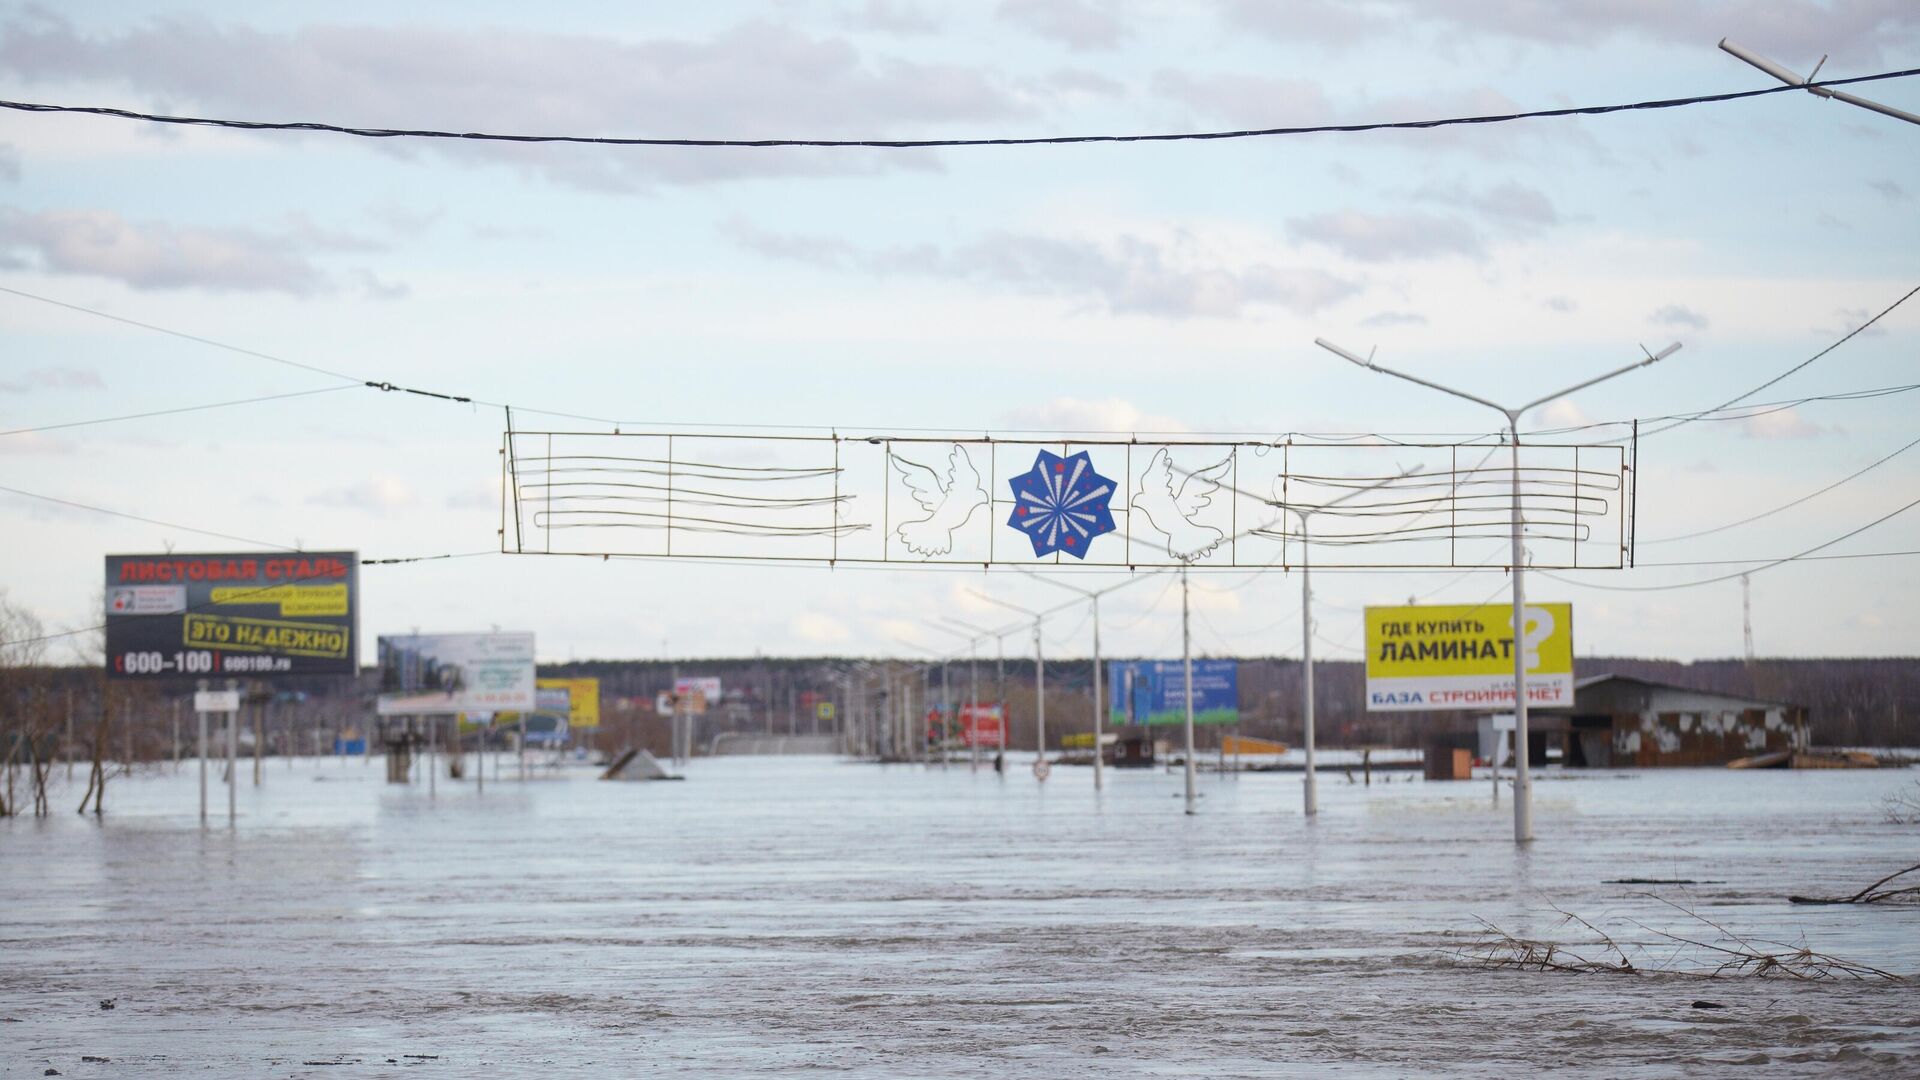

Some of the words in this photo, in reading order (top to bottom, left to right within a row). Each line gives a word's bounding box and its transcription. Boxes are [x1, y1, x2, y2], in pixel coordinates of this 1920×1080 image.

[120, 559, 257, 582] ЛИСТОВАЯ
[265, 558, 348, 578] СТАЛЬ
[191, 621, 230, 643] ЭТО
[236, 624, 341, 651] НАДЕЖНО
[1380, 622, 1412, 637] ГДЕ
[1416, 620, 1485, 636] КУПИТЬ
[1379, 638, 1515, 662] ЛАМИНАТ
[124, 651, 212, 673] 600-100
[1371, 690, 1423, 705] БАЗА
[1428, 687, 1563, 704] СТРОЙМАКЕТ
